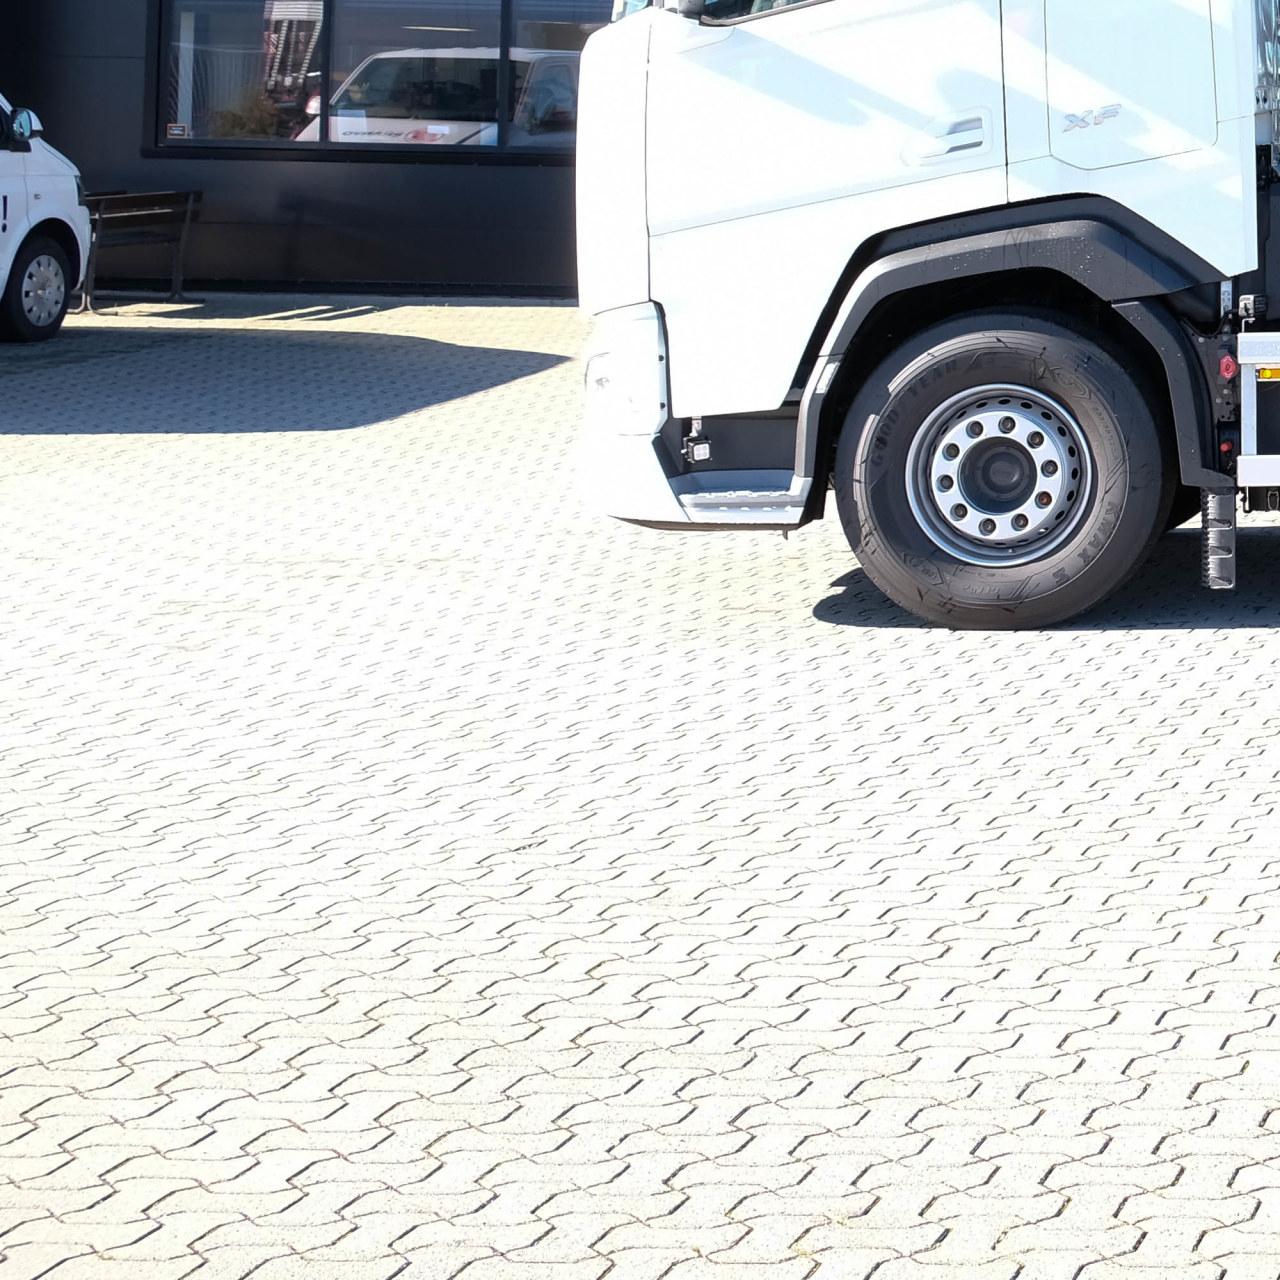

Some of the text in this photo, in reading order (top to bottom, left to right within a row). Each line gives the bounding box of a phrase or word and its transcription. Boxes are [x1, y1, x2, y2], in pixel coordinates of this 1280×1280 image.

[1062, 103, 1122, 133] XF
[1074, 499, 1124, 566] KMAX
[1050, 565, 1072, 587] S
